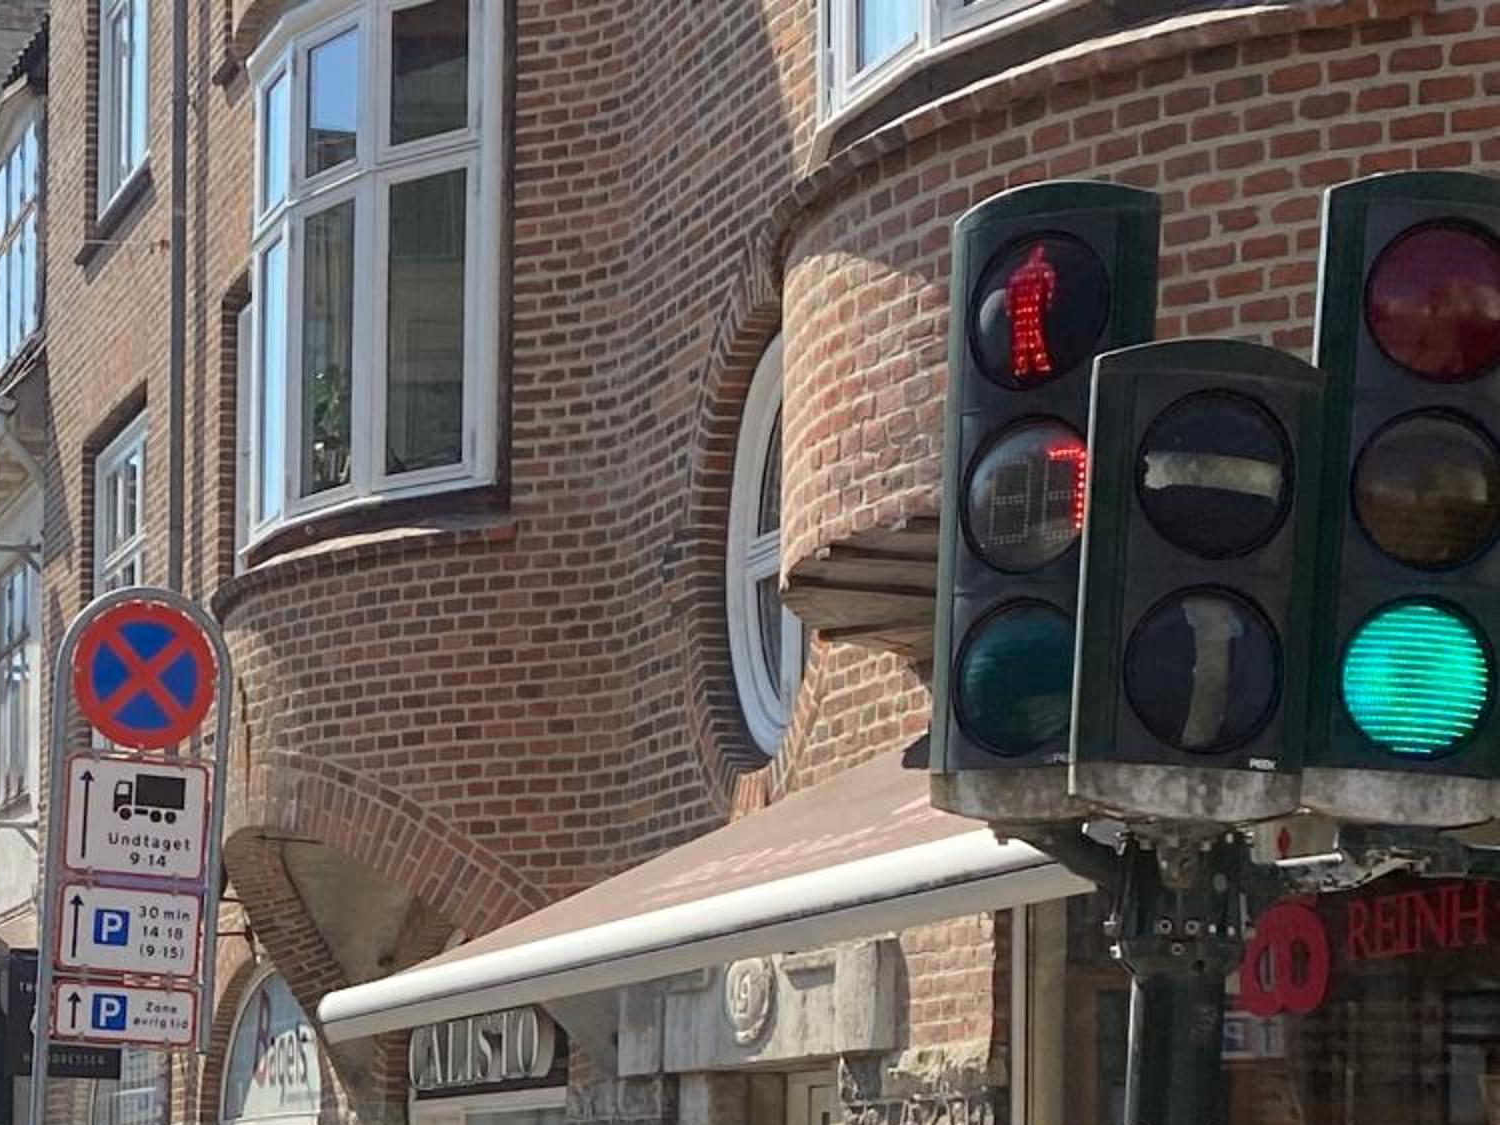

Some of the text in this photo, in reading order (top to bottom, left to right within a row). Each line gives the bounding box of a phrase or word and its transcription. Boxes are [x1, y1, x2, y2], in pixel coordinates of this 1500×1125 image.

[108, 832, 192, 851] Undtaget
[138, 905, 192, 921] 30 min
[1348, 879, 1487, 960] REINH
[101, 911, 124, 942] P
[100, 997, 122, 1028] P
[145, 1001, 179, 1014] Zone
[170, 1018, 189, 1030] tid
[409, 1007, 545, 1089] CALISTO
